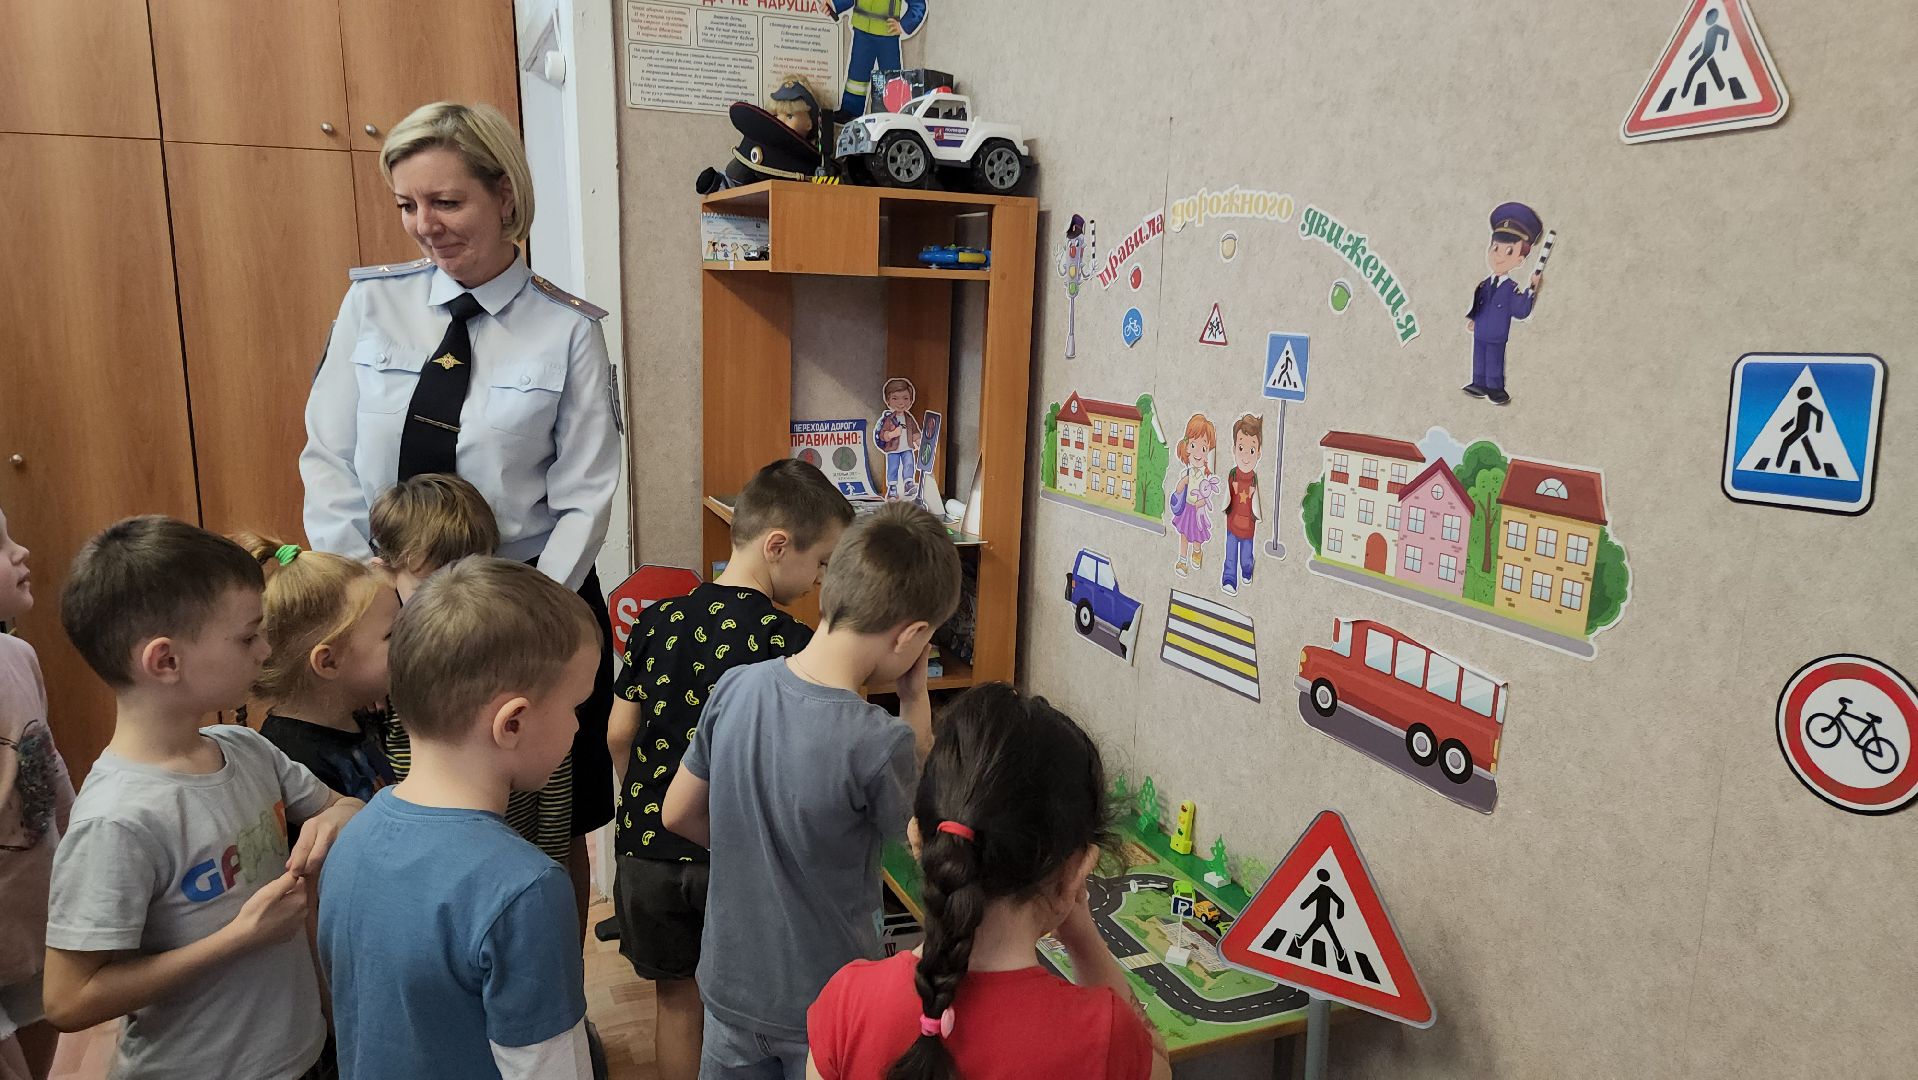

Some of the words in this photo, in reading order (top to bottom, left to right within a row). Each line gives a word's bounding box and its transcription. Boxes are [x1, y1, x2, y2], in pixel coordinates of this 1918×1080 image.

[1096, 213, 1165, 288] правила
[1171, 189, 1293, 226] дорожного
[1300, 207, 1417, 342] движения
[793, 422, 830, 433] ПЕРЕХОДИ
[830, 421, 857, 432] ДОРОГУ
[790, 431, 862, 448] ПРАВИЛЬНО:
